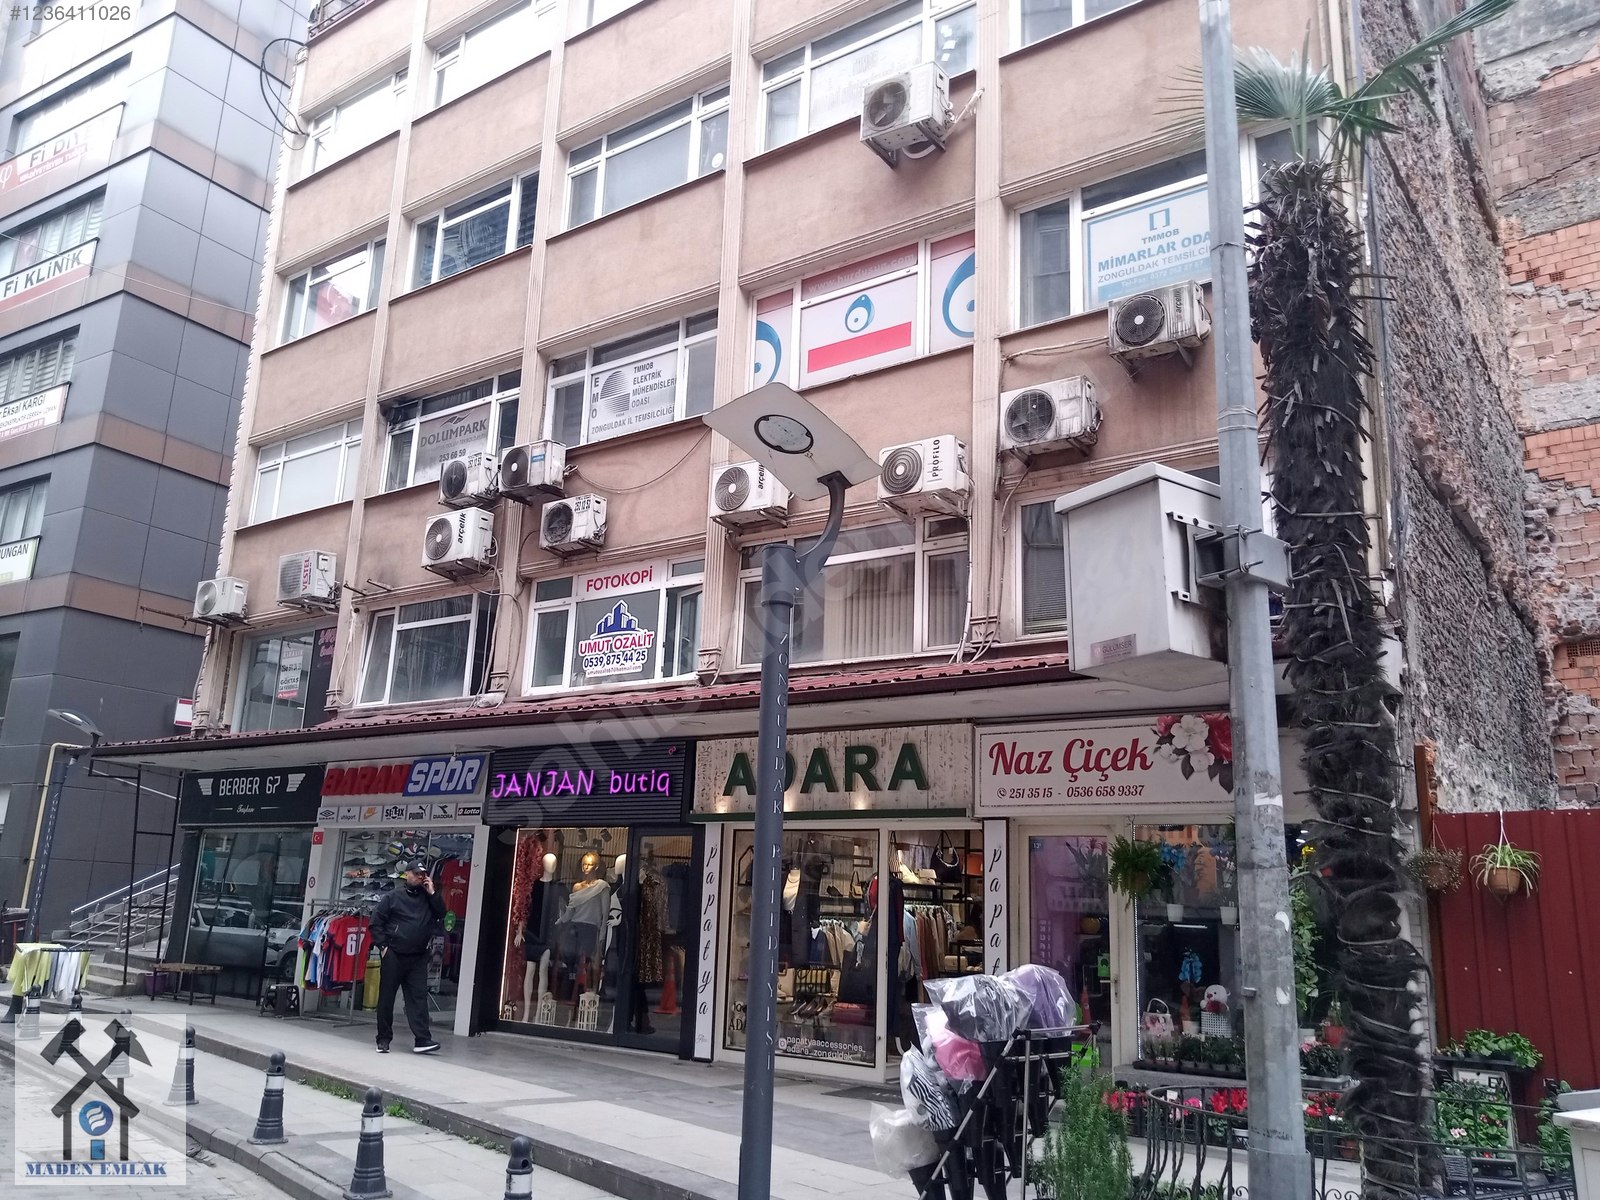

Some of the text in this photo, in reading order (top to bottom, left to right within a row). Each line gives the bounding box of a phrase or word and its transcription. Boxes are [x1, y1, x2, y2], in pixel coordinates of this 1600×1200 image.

[1141, 228, 1180, 245] TMMOB
[1097, 259, 1159, 283] ZONGULDAK
[1161, 246, 1211, 266] TEMSİLCİ
[1098, 241, 1177, 272] MİMARLAR
[1181, 231, 1211, 248] ODA
[633, 361, 654, 374] TMMOB
[633, 370, 662, 386] ELEKTRİK
[631, 397, 650, 409] ODASI
[420, 419, 488, 448] DOLUMPARK
[591, 419, 626, 435] ZONGULDAK
[457, 512, 467, 544] arçelik
[586, 565, 653, 592] FOTOKOPİ
[580, 632, 654, 655] UMUT OZALİT
[606, 653, 621, 666] 875
[621, 651, 634, 663] 44
[636, 650, 646, 662] 25
[988, 737, 1154, 783] Naz Çiçek
[219, 775, 281, 796] BERBER 67
[320, 758, 481, 797] BARAN SPOR
[491, 769, 670, 799] JANJAN butiq
[1009, 787, 1025, 799] 251
[1027, 787, 1041, 799] 35
[1042, 787, 1053, 799] 15
[1066, 786, 1094, 798] 0536
[1096, 785, 1116, 798] 658
[1117, 784, 1145, 797] 9337
[988, 847, 1003, 977] papat
[697, 844, 718, 1016] papatya
